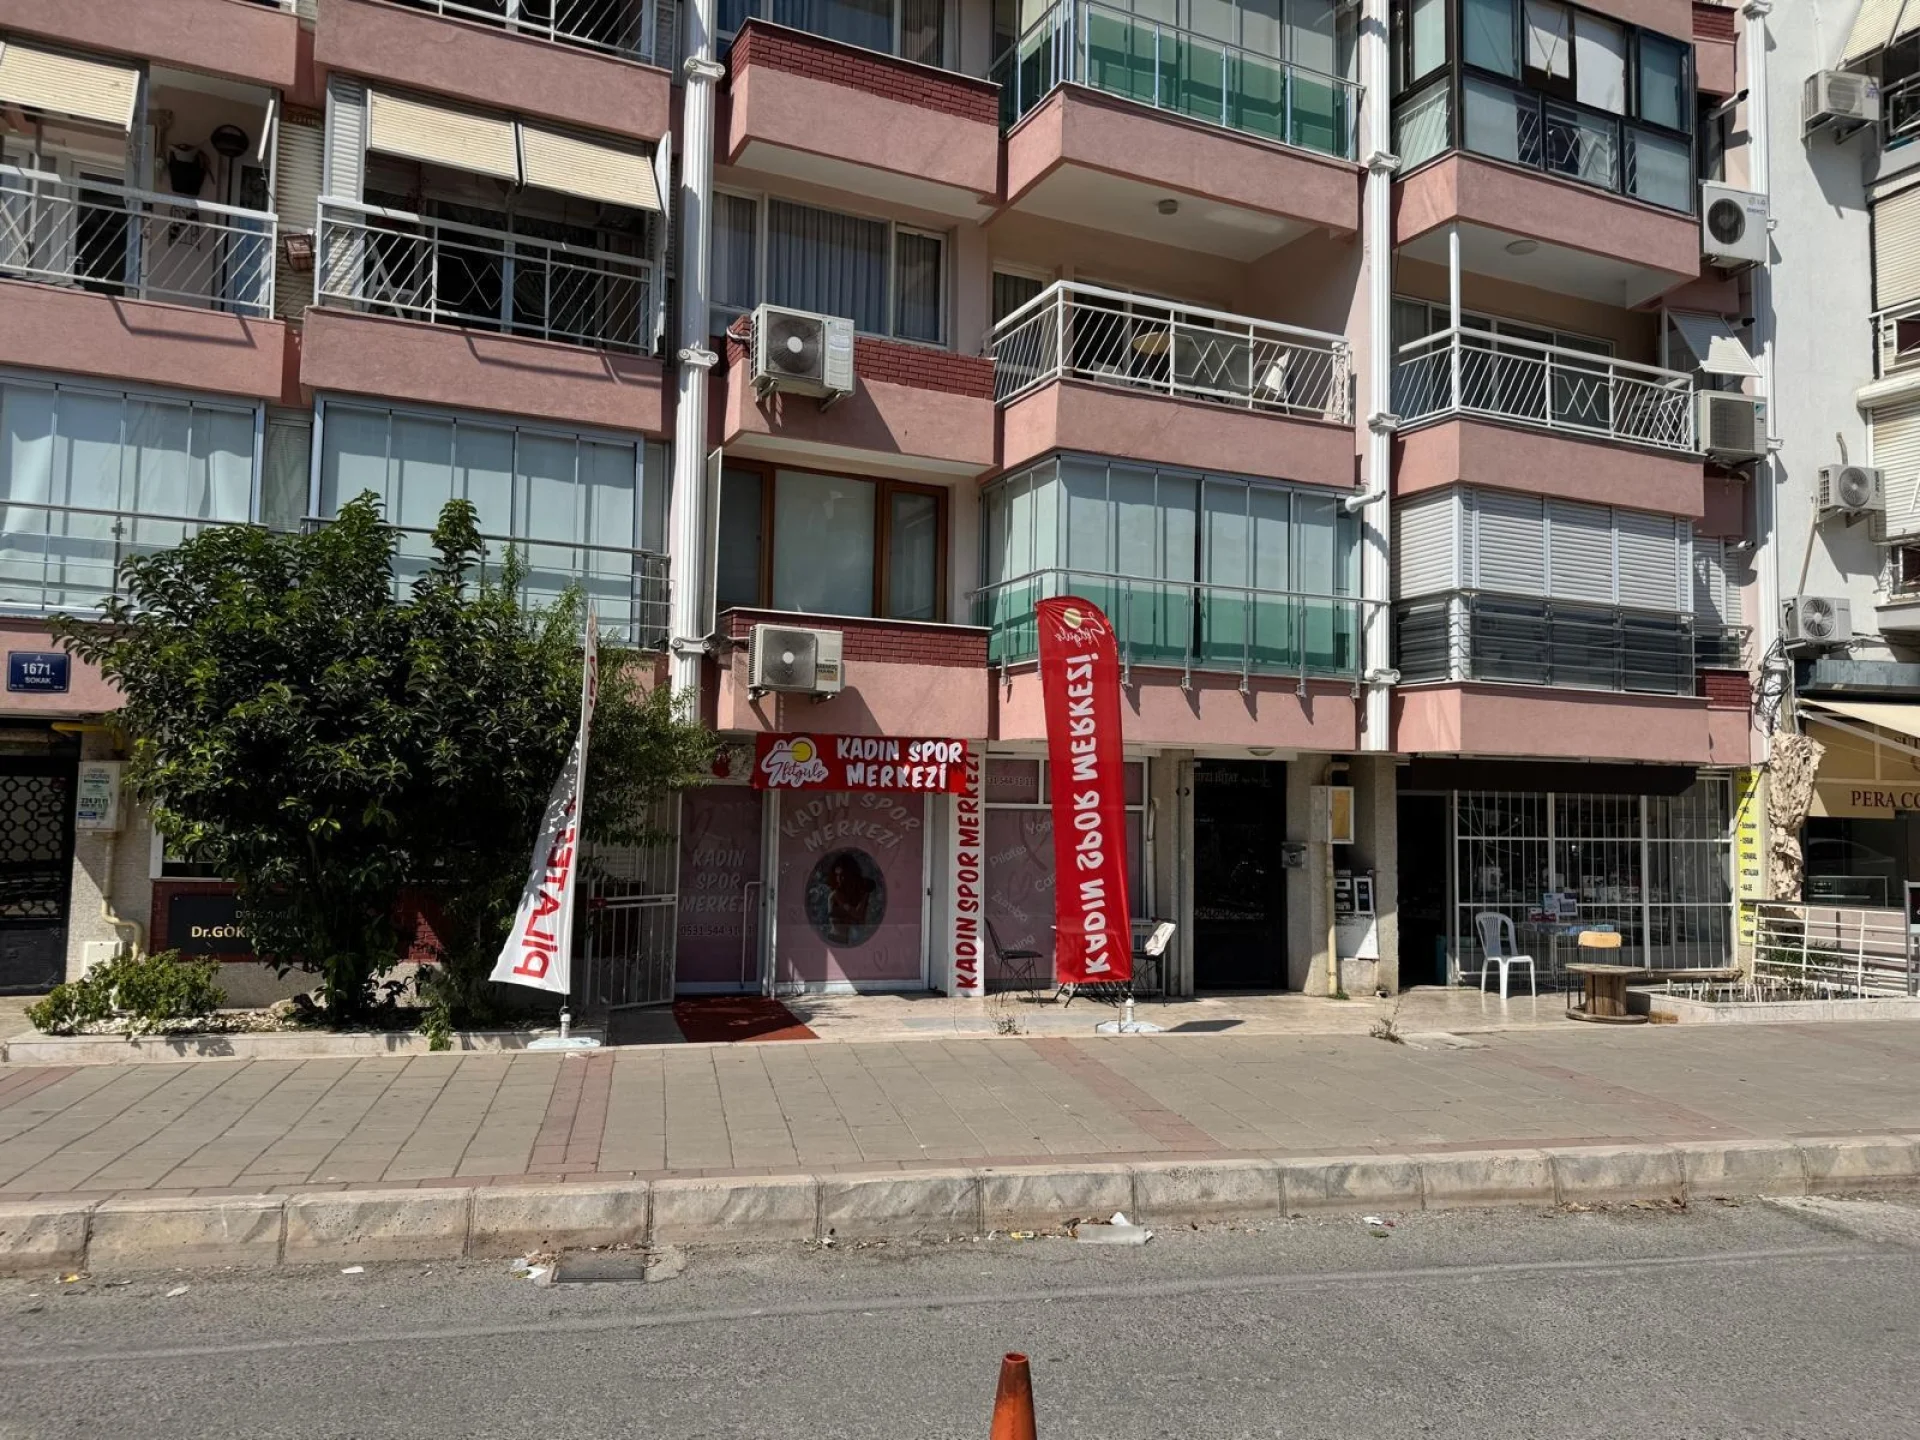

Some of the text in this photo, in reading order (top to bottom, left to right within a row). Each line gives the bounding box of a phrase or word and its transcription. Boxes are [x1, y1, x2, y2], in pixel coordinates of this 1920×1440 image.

[836, 738, 962, 763] KADIN SPOR
[846, 762, 947, 789] MERKEZİ
[1851, 790, 1896, 807] PERA
[780, 791, 920, 837] KADIN SPOR
[803, 820, 903, 852] MERKEZİ
[691, 848, 747, 867] KADIN
[695, 872, 741, 889] SPOR
[956, 852, 979, 913] SPOR
[955, 916, 978, 989] KADIN
